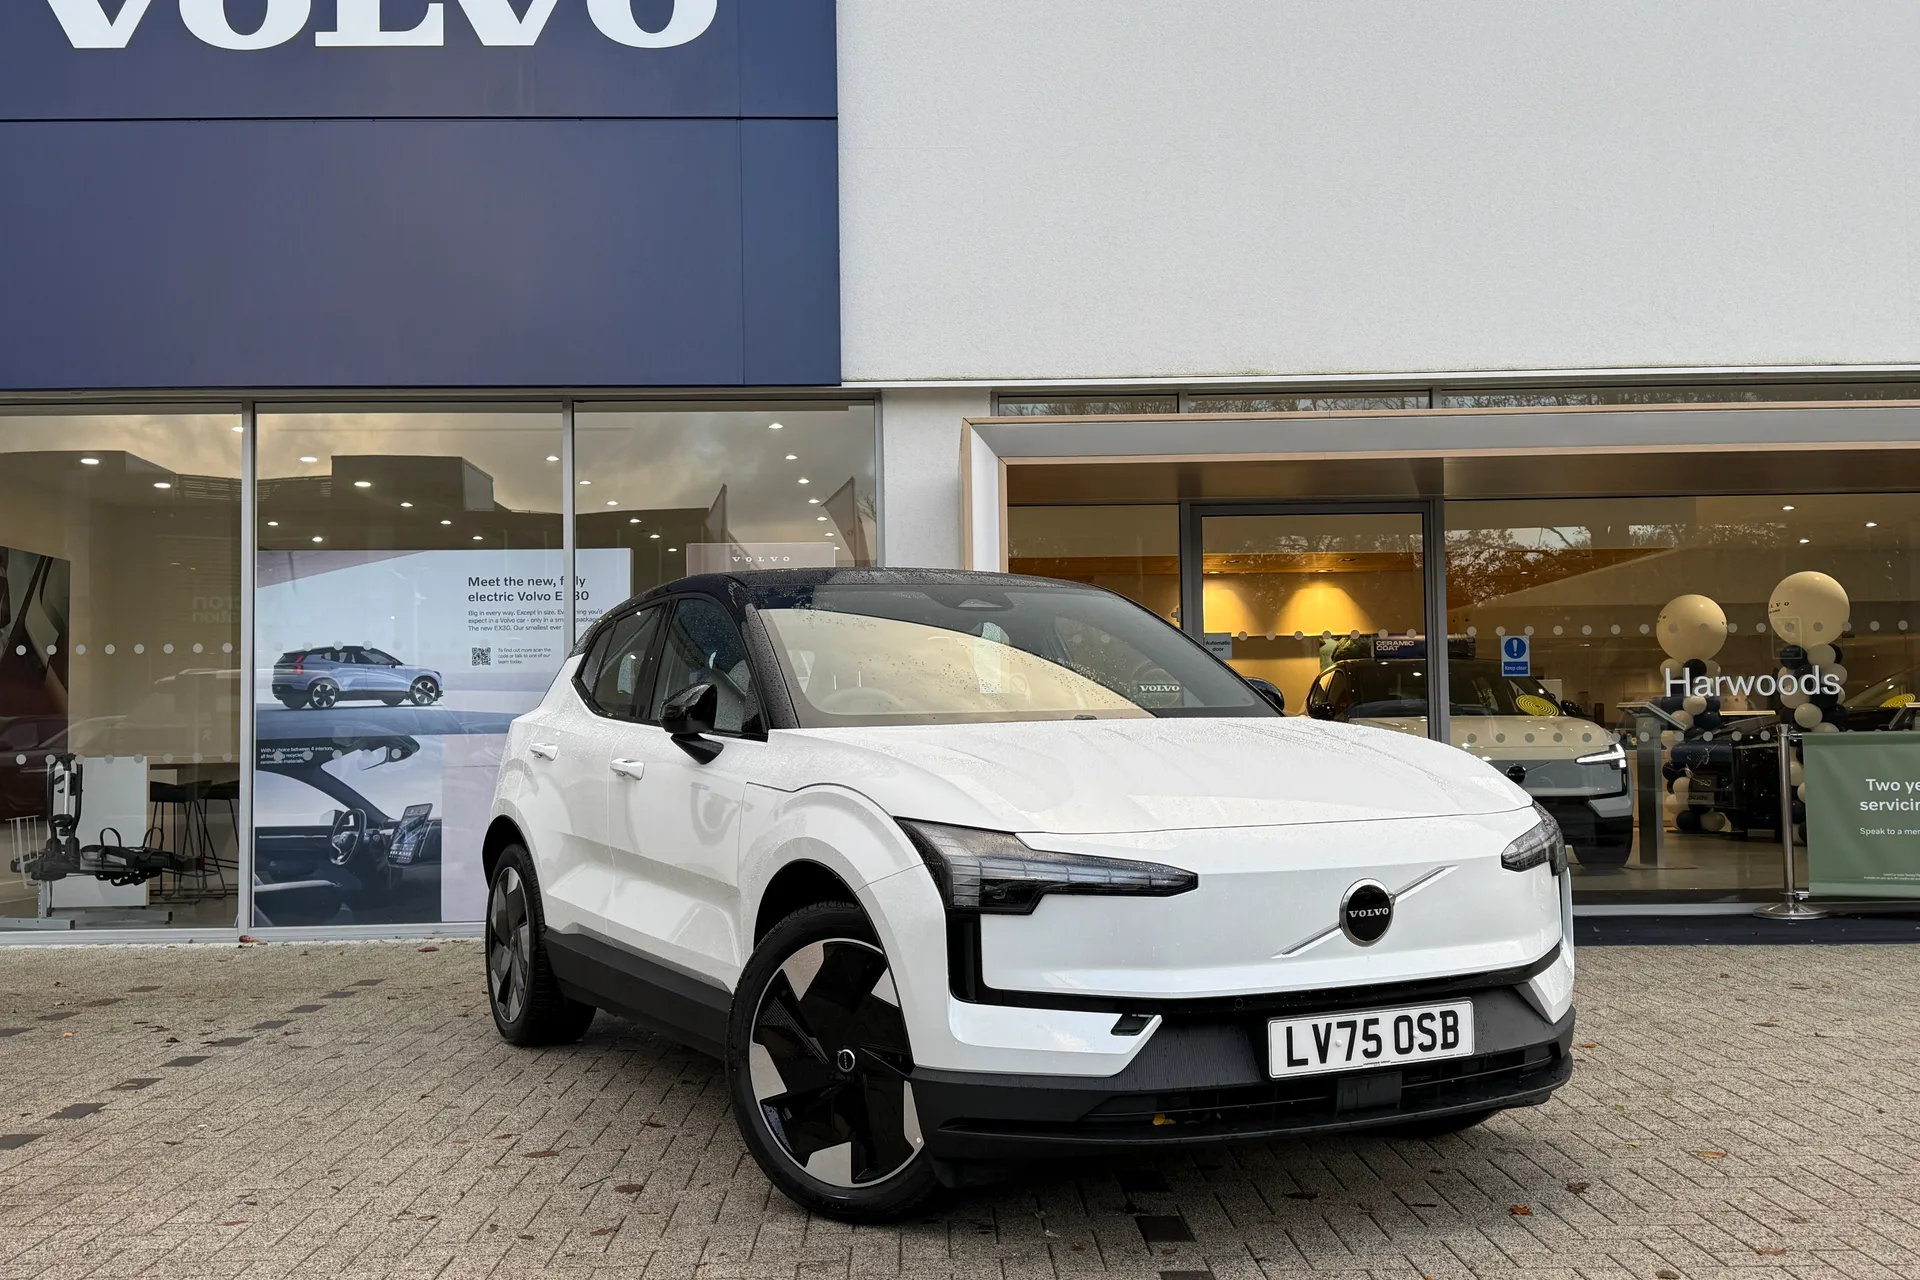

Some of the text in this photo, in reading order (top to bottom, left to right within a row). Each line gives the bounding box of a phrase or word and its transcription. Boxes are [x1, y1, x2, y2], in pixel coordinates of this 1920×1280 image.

[468, 576, 586, 588] Meet the new, fly
[468, 591, 590, 602] electric Volvo E30
[1665, 665, 1841, 698] Harwoods
[1139, 684, 1180, 692] VOLVO
[1865, 778, 1901, 791] Two
[1860, 827, 1886, 836] Speak
[1348, 907, 1390, 918] VOLVO
[1286, 1009, 1460, 1068] LV75 OSB
